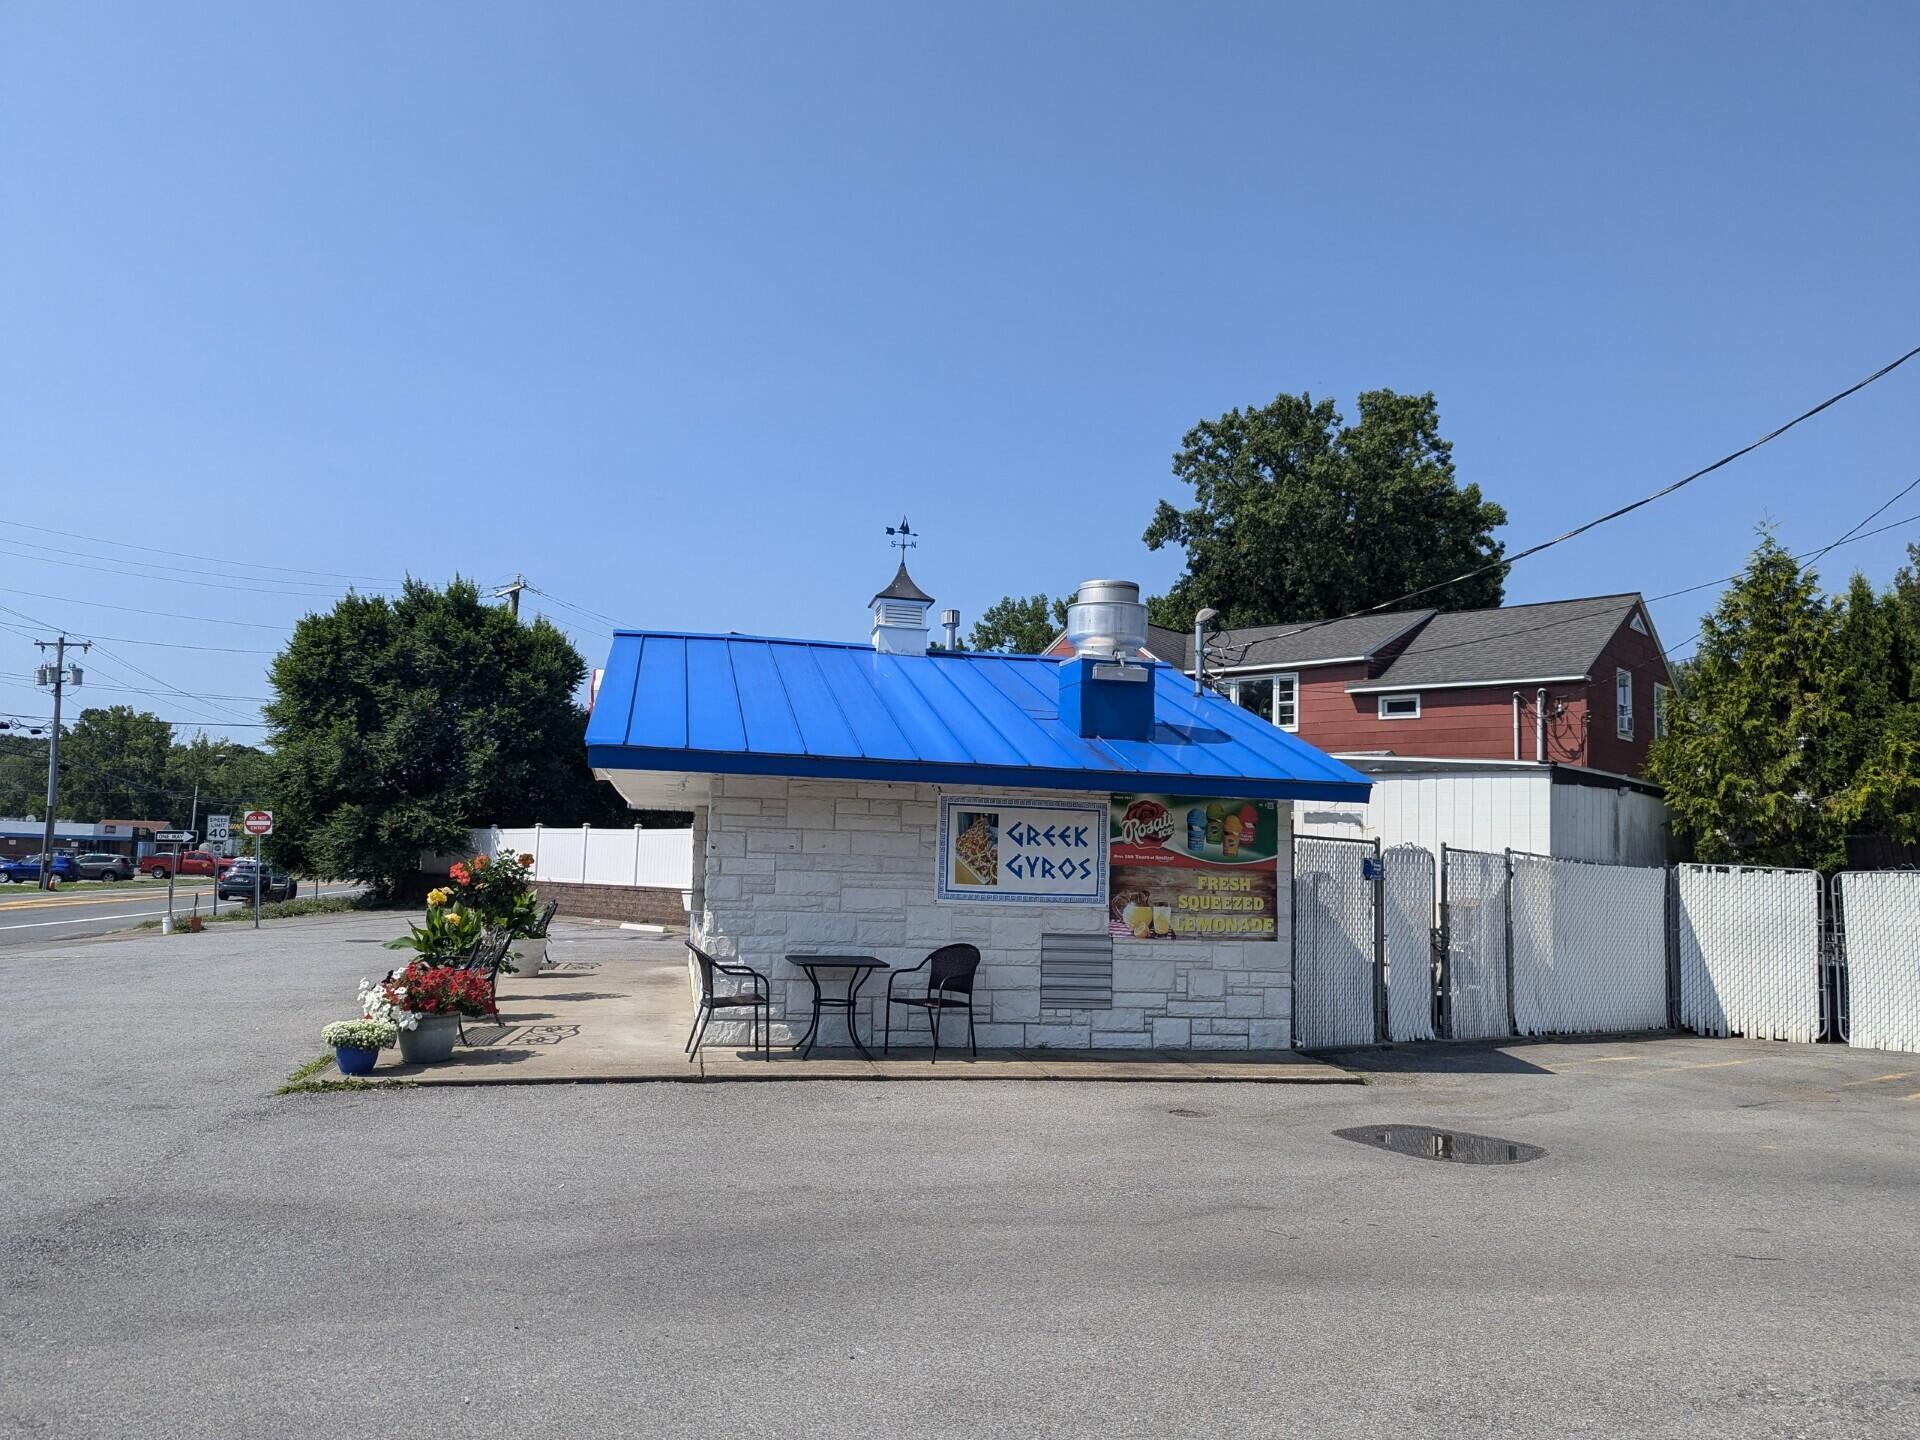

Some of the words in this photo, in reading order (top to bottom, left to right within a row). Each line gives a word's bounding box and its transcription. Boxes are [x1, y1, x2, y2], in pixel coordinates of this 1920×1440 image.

[209, 828, 227, 838] 40
[1006, 821, 1089, 847] GREEK
[1005, 853, 1092, 880] GYROS
[1197, 876, 1251, 891] FRESH
[1178, 895, 1264, 911] SQUEEZED
[1173, 915, 1275, 933] LEMONADE
